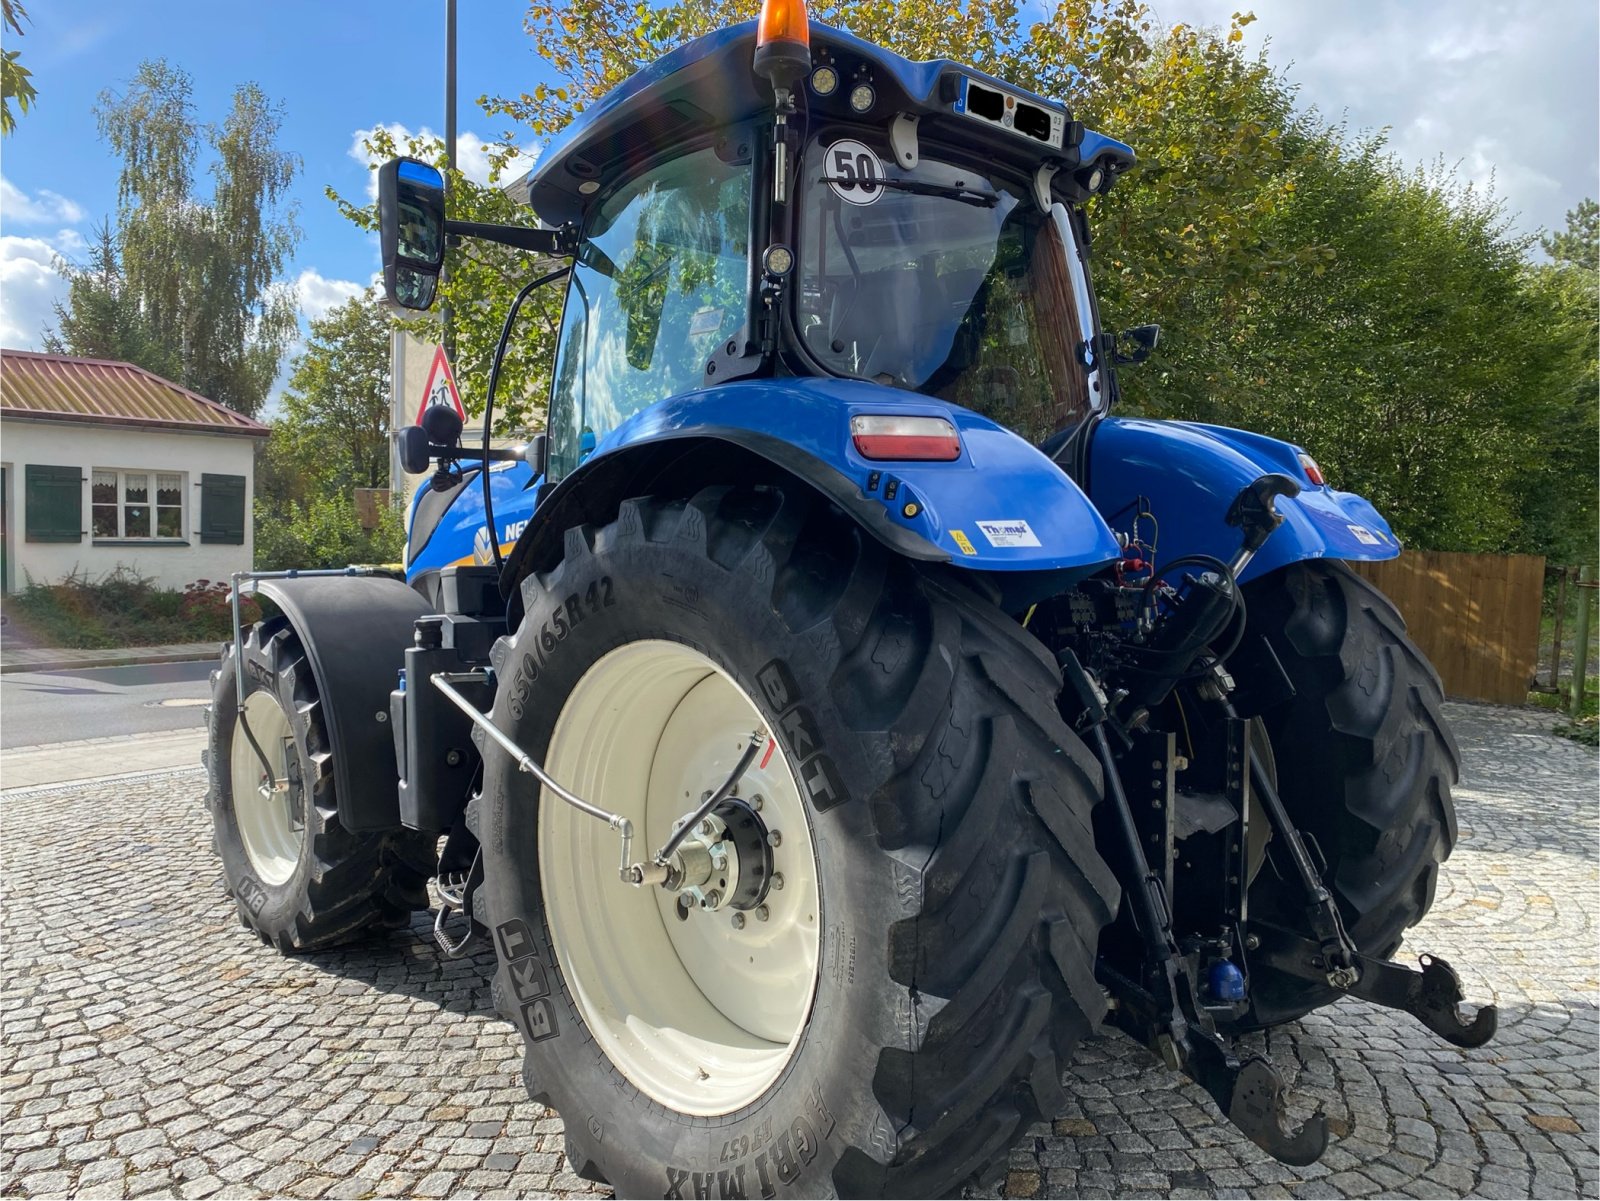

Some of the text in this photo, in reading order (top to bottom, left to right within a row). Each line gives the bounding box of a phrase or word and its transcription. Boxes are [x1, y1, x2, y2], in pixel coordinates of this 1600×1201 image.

[1053, 116, 1062, 126] 03
[834, 150, 877, 194] 50
[507, 576, 616, 720] 650/65R42
[759, 662, 839, 802] BKT
[238, 879, 266, 914] BKT
[499, 925, 553, 1039] BKT
[720, 1135, 750, 1164] 657
